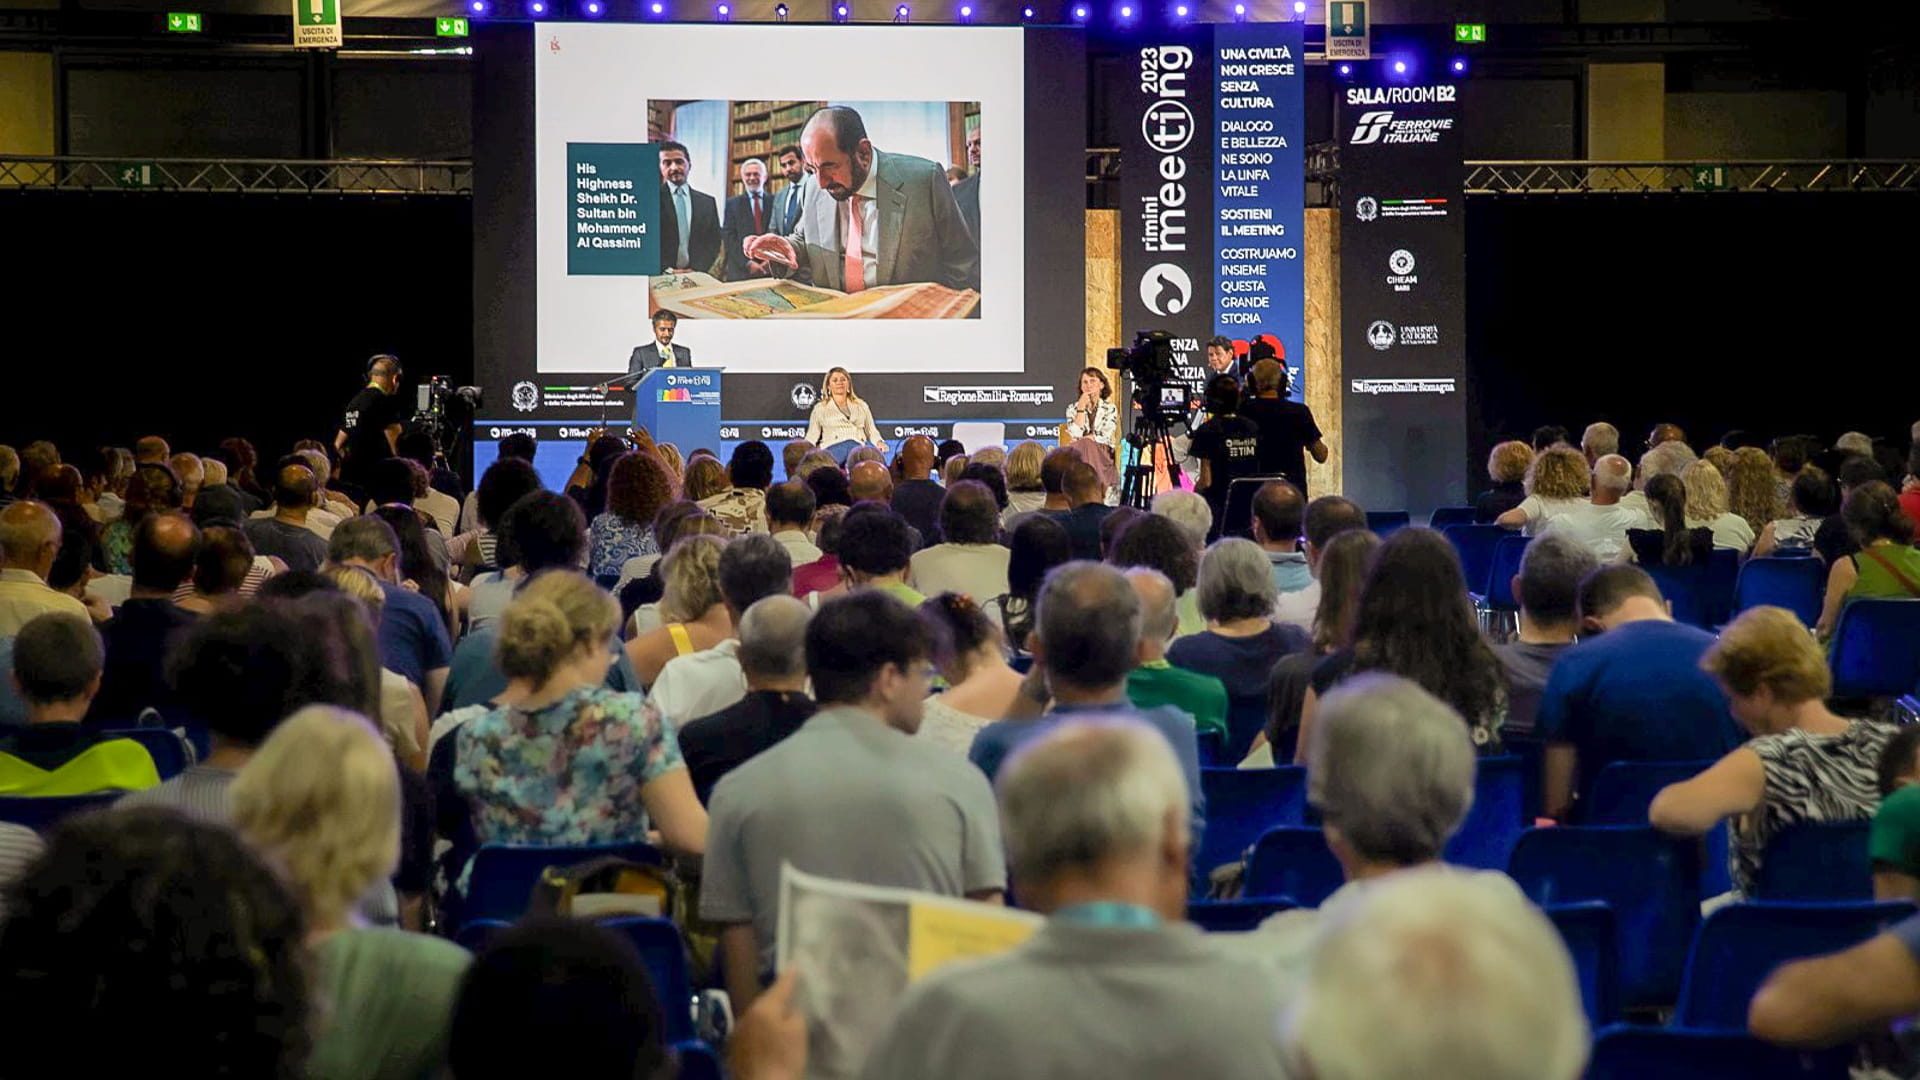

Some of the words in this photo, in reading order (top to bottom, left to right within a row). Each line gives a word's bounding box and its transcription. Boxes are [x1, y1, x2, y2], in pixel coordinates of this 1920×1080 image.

[1221, 48, 1246, 60] UNA
[1248, 45, 1291, 59] CIVILTÀ
[1141, 47, 1158, 93] 2023
[1221, 64, 1247, 76] NON
[1249, 64, 1294, 75] CRESCE
[1221, 81, 1259, 92] SENZA
[1221, 97, 1274, 108] CULTURA
[1221, 121, 1273, 132] DIALOGO
[1389, 119, 1453, 130] FERROVIE
[1221, 138, 1229, 148] E
[1231, 137, 1287, 148] BELLEZZA
[1383, 132, 1440, 143] ITALIANE
[1153, 46, 1193, 251] meeting
[1221, 154, 1237, 164] NE
[1239, 153, 1273, 164] SONO
[577, 163, 596, 174] His
[1221, 170, 1236, 180] LA
[1238, 169, 1270, 180] LINFA
[577, 178, 633, 191] Highness
[1221, 186, 1258, 197] VITALE
[577, 192, 618, 204] Sheikh
[620, 193, 638, 204] Dr.
[577, 207, 615, 219] Sultan
[618, 207, 637, 219] bin
[1221, 209, 1272, 220] SOSTIENI
[577, 222, 646, 234] Mohammed
[1142, 196, 1158, 251] rimini
[1221, 225, 1232, 236] IL
[1234, 225, 1284, 236] MEETING
[577, 237, 590, 248] Al
[592, 237, 641, 248] Qassimi
[1221, 248, 1297, 260] COSTRUIAMO
[1221, 265, 1267, 276] INSIEME
[1221, 281, 1266, 293] QUESTA
[1221, 297, 1269, 308] GRANDE
[1221, 313, 1261, 324] STORIA
[1239, 446, 1255, 457] TIM
